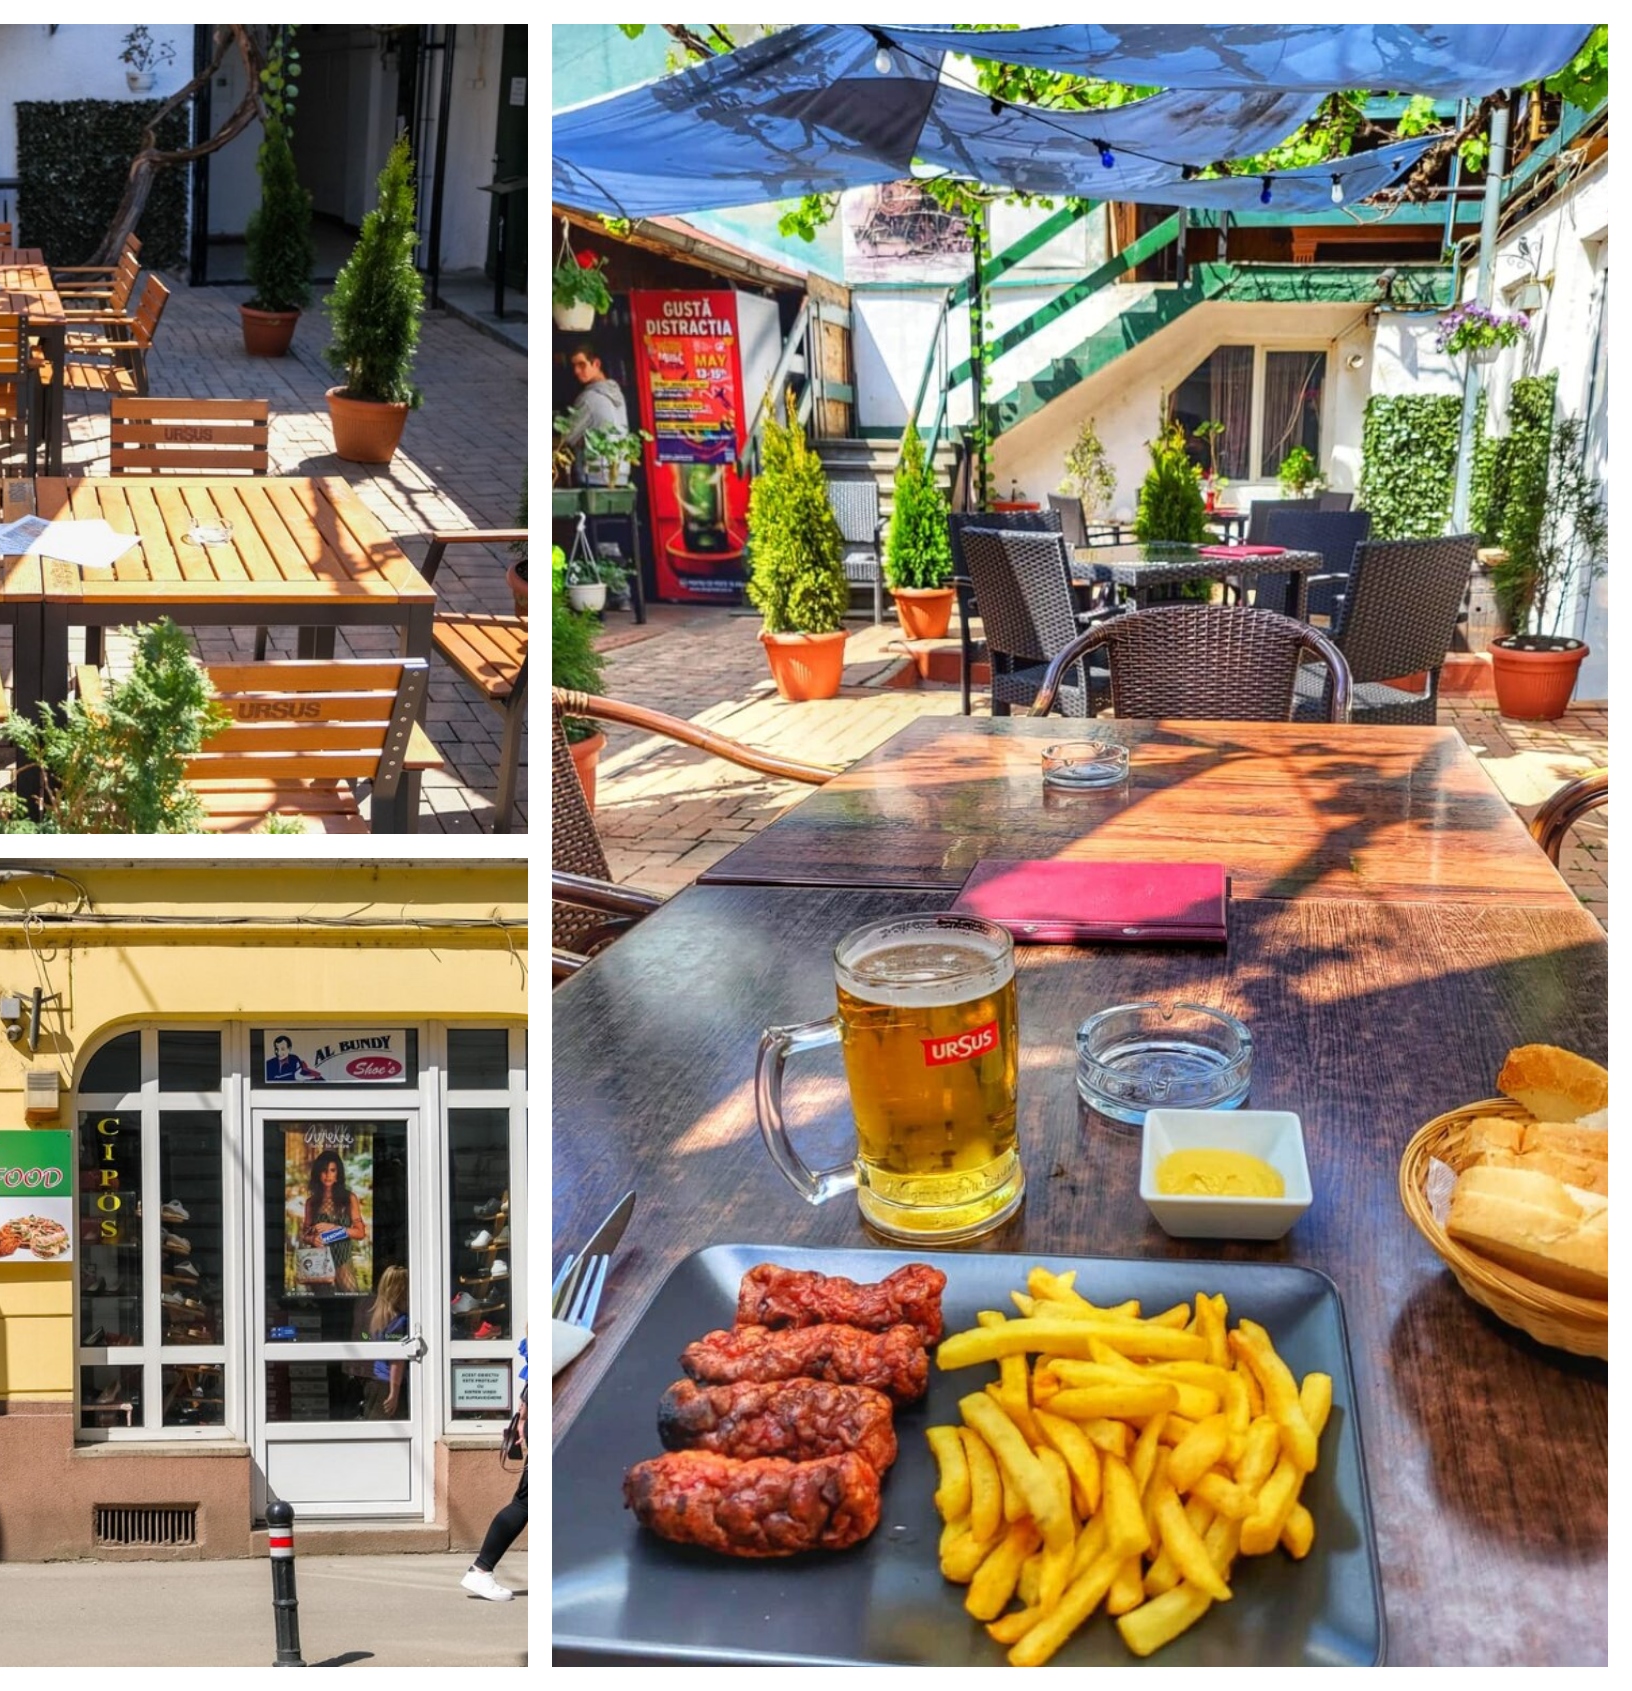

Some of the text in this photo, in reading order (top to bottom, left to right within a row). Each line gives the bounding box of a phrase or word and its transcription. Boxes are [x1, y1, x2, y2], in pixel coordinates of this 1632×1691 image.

[694, 353, 727, 367] MAY
[164, 426, 213, 442] URSUS
[237, 702, 322, 719] URSUS
[314, 1035, 392, 1066] AL BUNDY
[931, 1029, 993, 1060] URSUS
[352, 1061, 396, 1076] Shoe's
